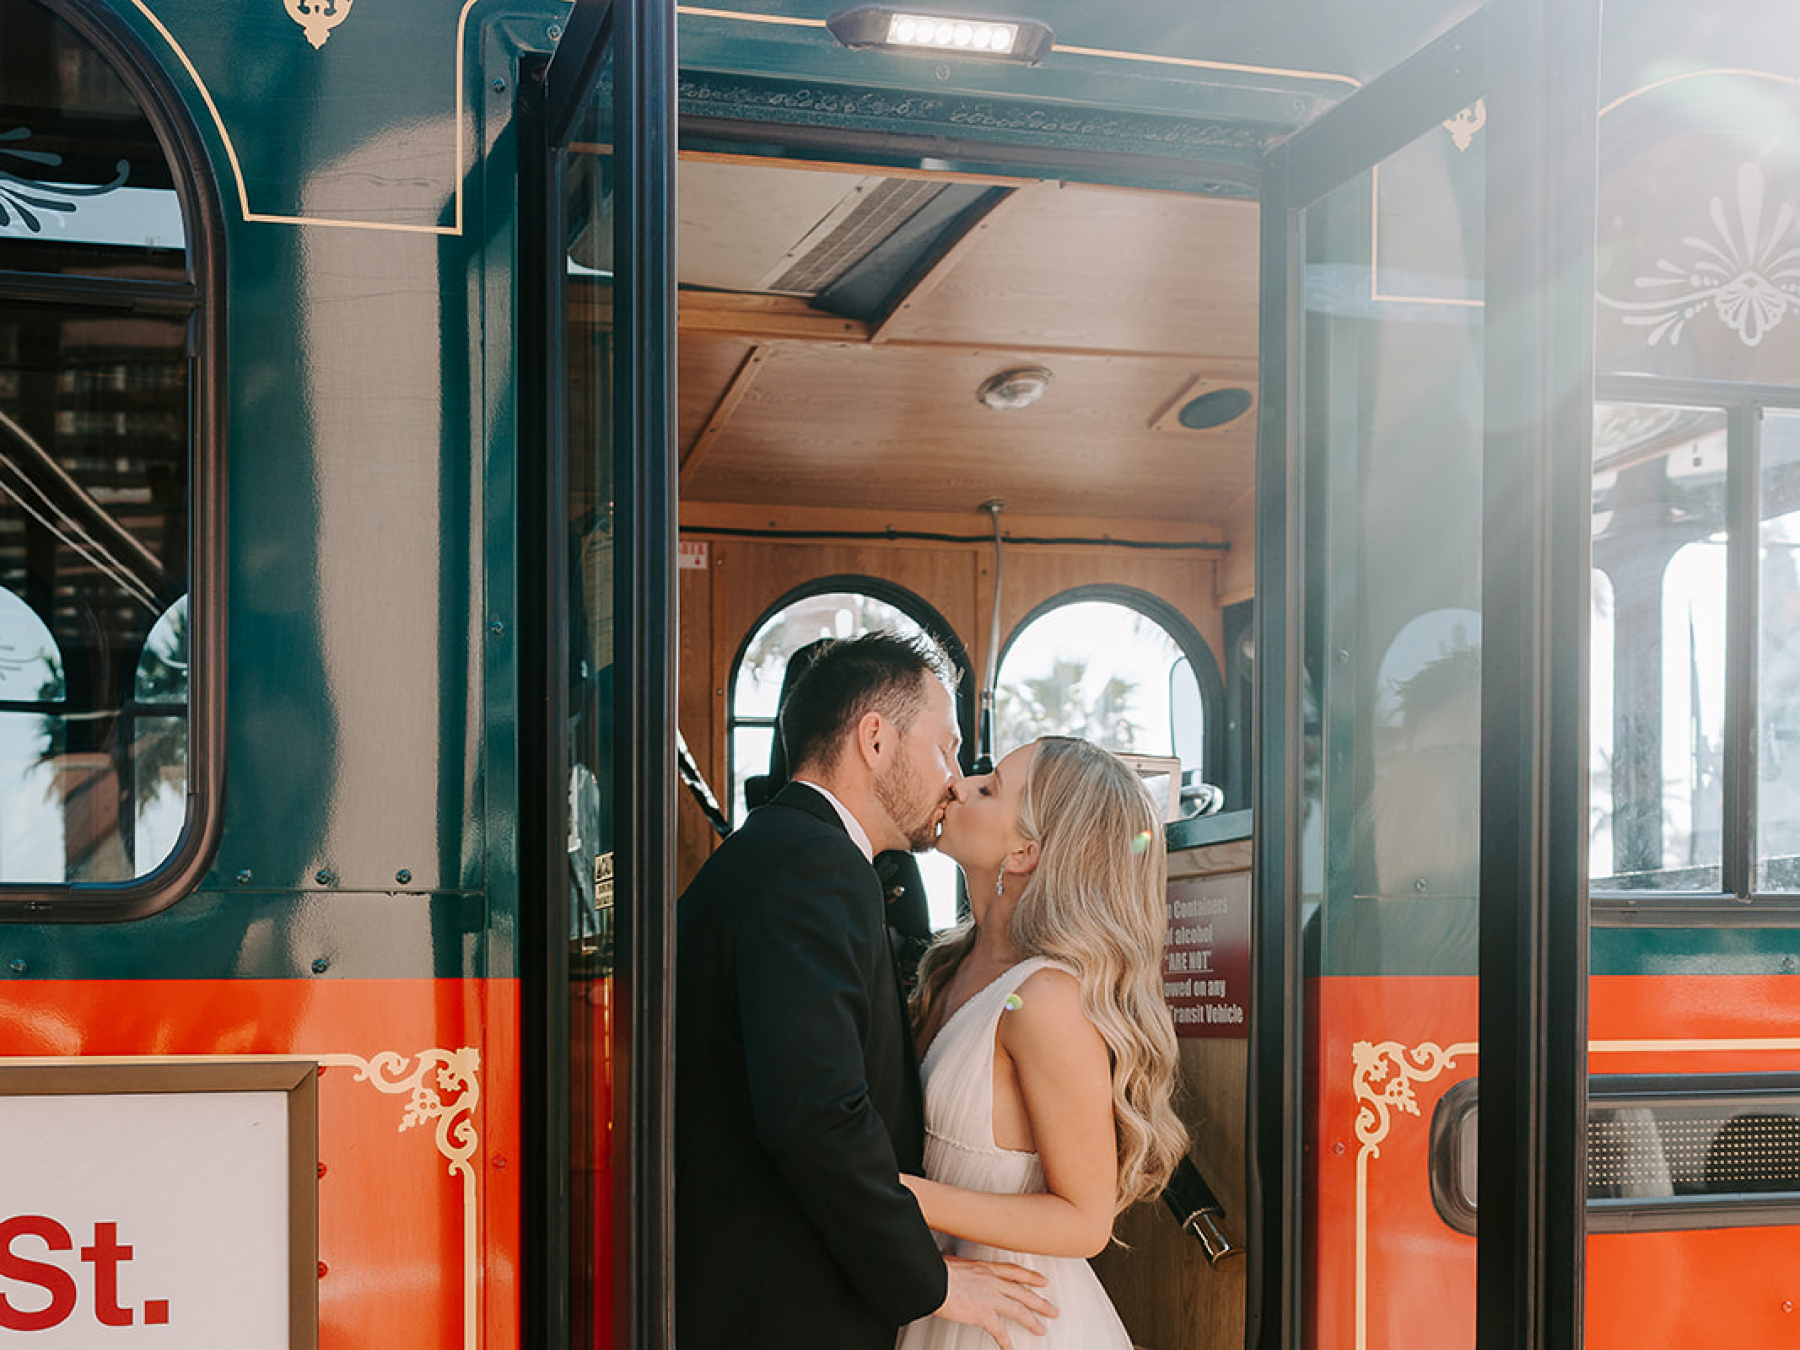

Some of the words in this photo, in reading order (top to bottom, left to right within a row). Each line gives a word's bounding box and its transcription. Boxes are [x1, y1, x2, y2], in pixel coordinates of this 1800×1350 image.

[1173, 897, 1228, 918] Containers
[1175, 923, 1213, 945] alcohol
[1194, 981, 1207, 997] on
[1208, 979, 1226, 997] any
[1205, 1003, 1244, 1023] Vehicle
[0, 1215, 169, 1331] St.
